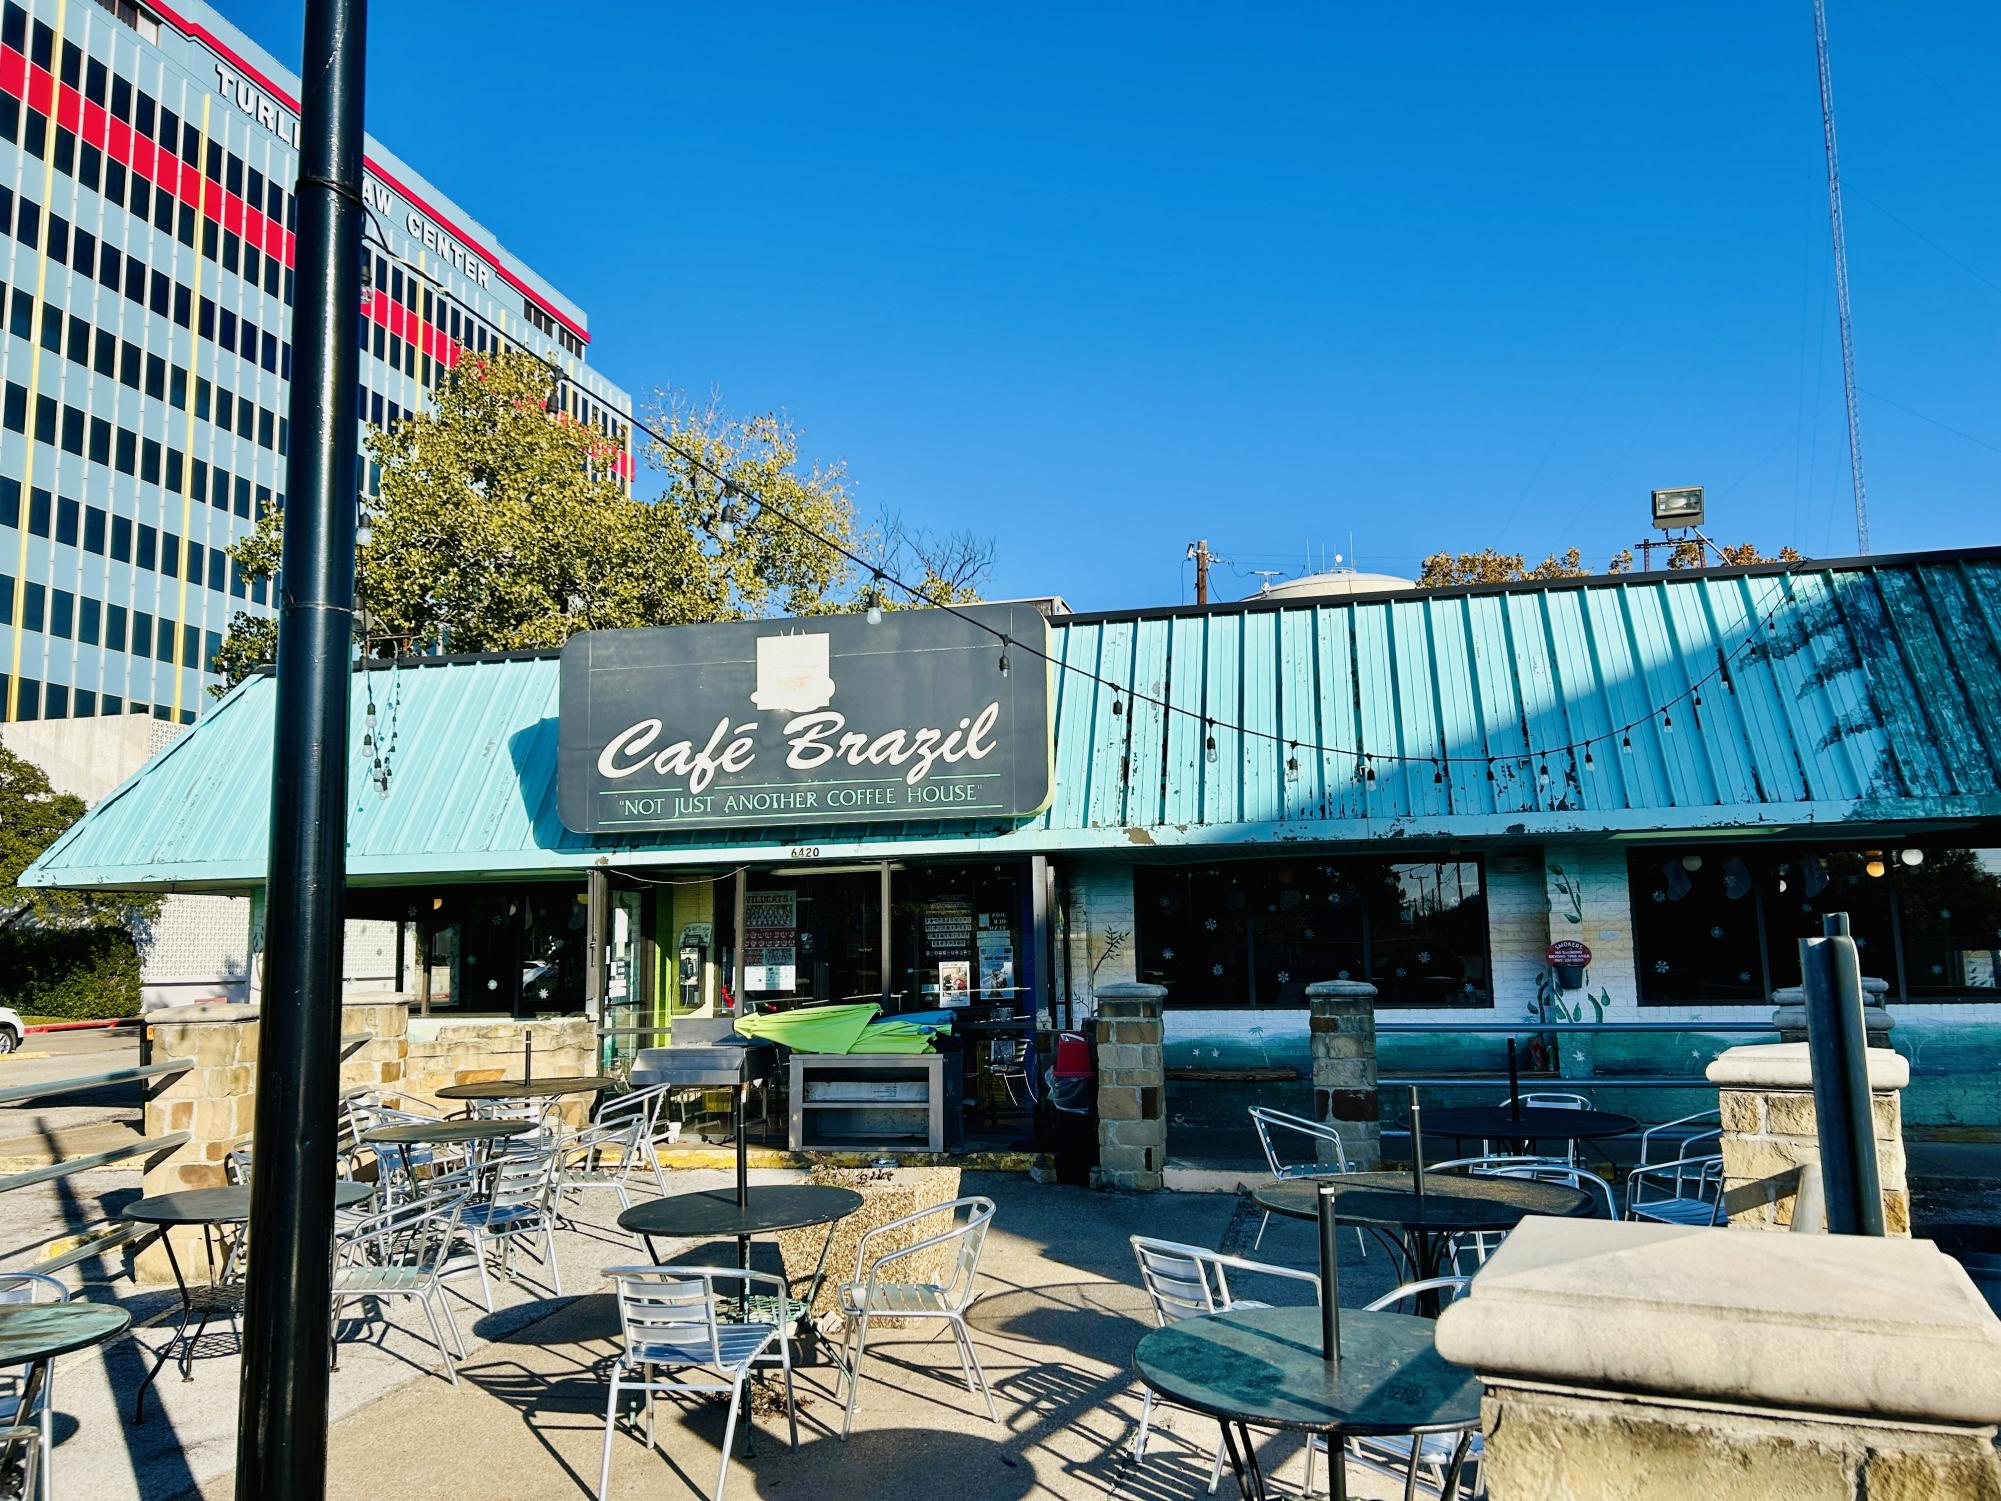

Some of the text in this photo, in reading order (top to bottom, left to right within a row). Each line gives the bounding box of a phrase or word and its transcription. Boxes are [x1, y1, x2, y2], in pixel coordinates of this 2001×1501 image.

[215, 63, 490, 291] TURL AW CENTER
[598, 702, 999, 795] Café Brazil
[674, 796, 715, 818] JUST
[724, 792, 818, 814] ANOTHER
[827, 788, 897, 807] COFFEE
[791, 847, 820, 858] 6420
[1554, 942, 1583, 950] SMOKERS
